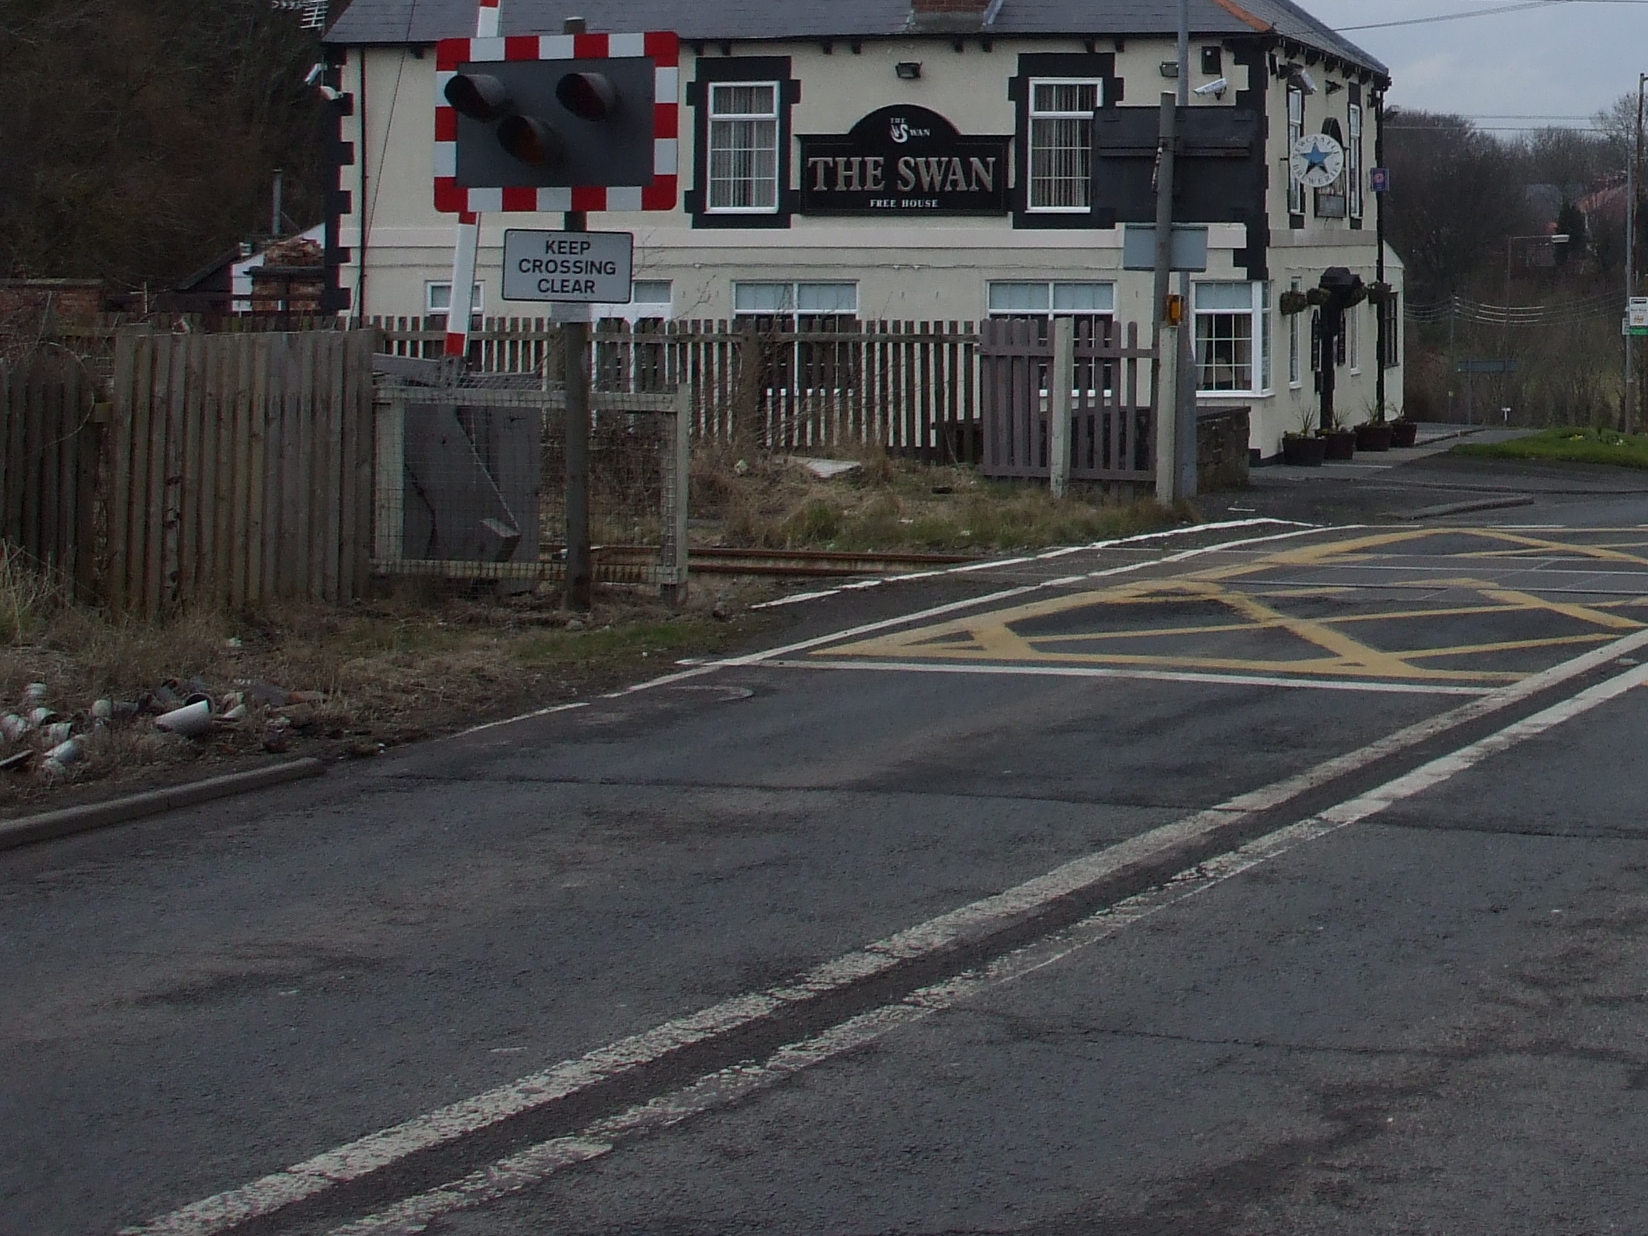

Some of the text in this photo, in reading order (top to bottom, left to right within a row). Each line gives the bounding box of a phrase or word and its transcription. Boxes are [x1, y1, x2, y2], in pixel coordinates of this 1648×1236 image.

[808, 156, 996, 192] THE SWAN
[870, 199, 938, 208] FREE HOUSE
[545, 240, 592, 255] KEEP
[518, 258, 616, 275] CROSSING
[538, 278, 595, 294] CLEAR
